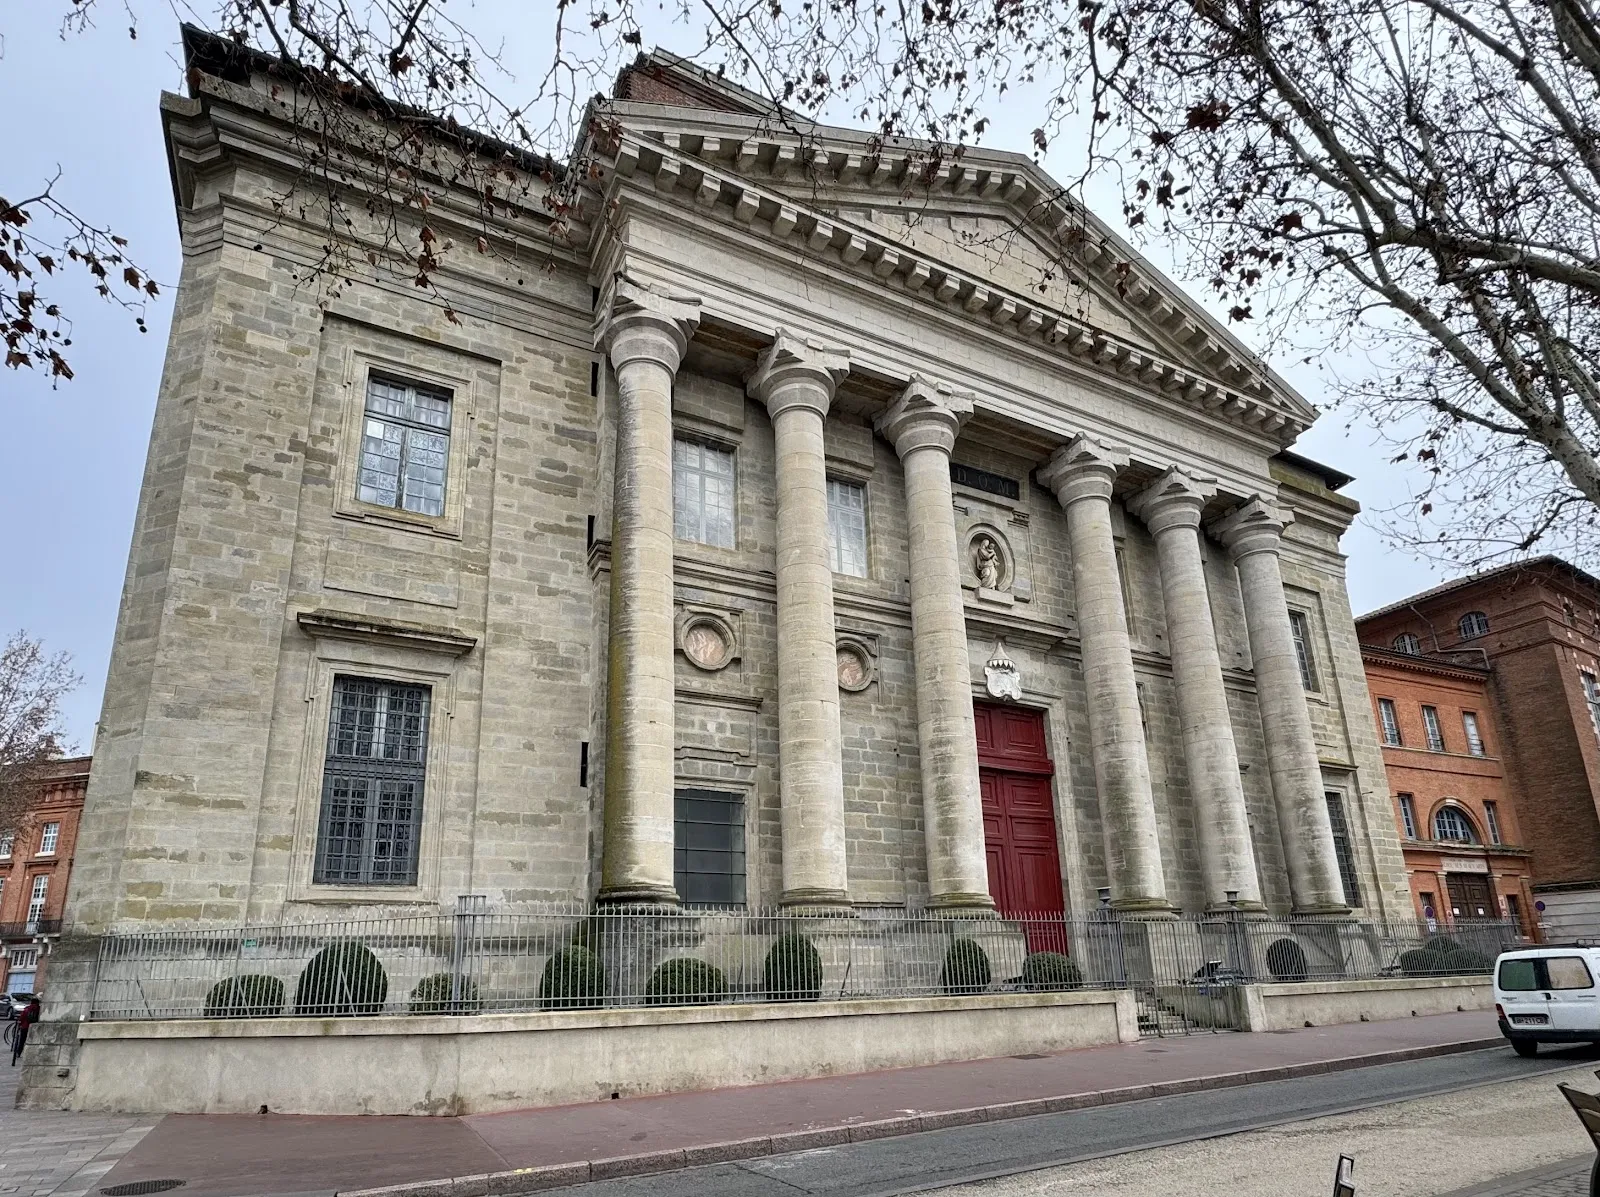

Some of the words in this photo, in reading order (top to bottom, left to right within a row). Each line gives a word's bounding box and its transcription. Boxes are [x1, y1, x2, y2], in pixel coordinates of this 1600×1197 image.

[957, 468, 971, 484] D.
[978, 475, 992, 490] O.
[998, 479, 1015, 497] M.
